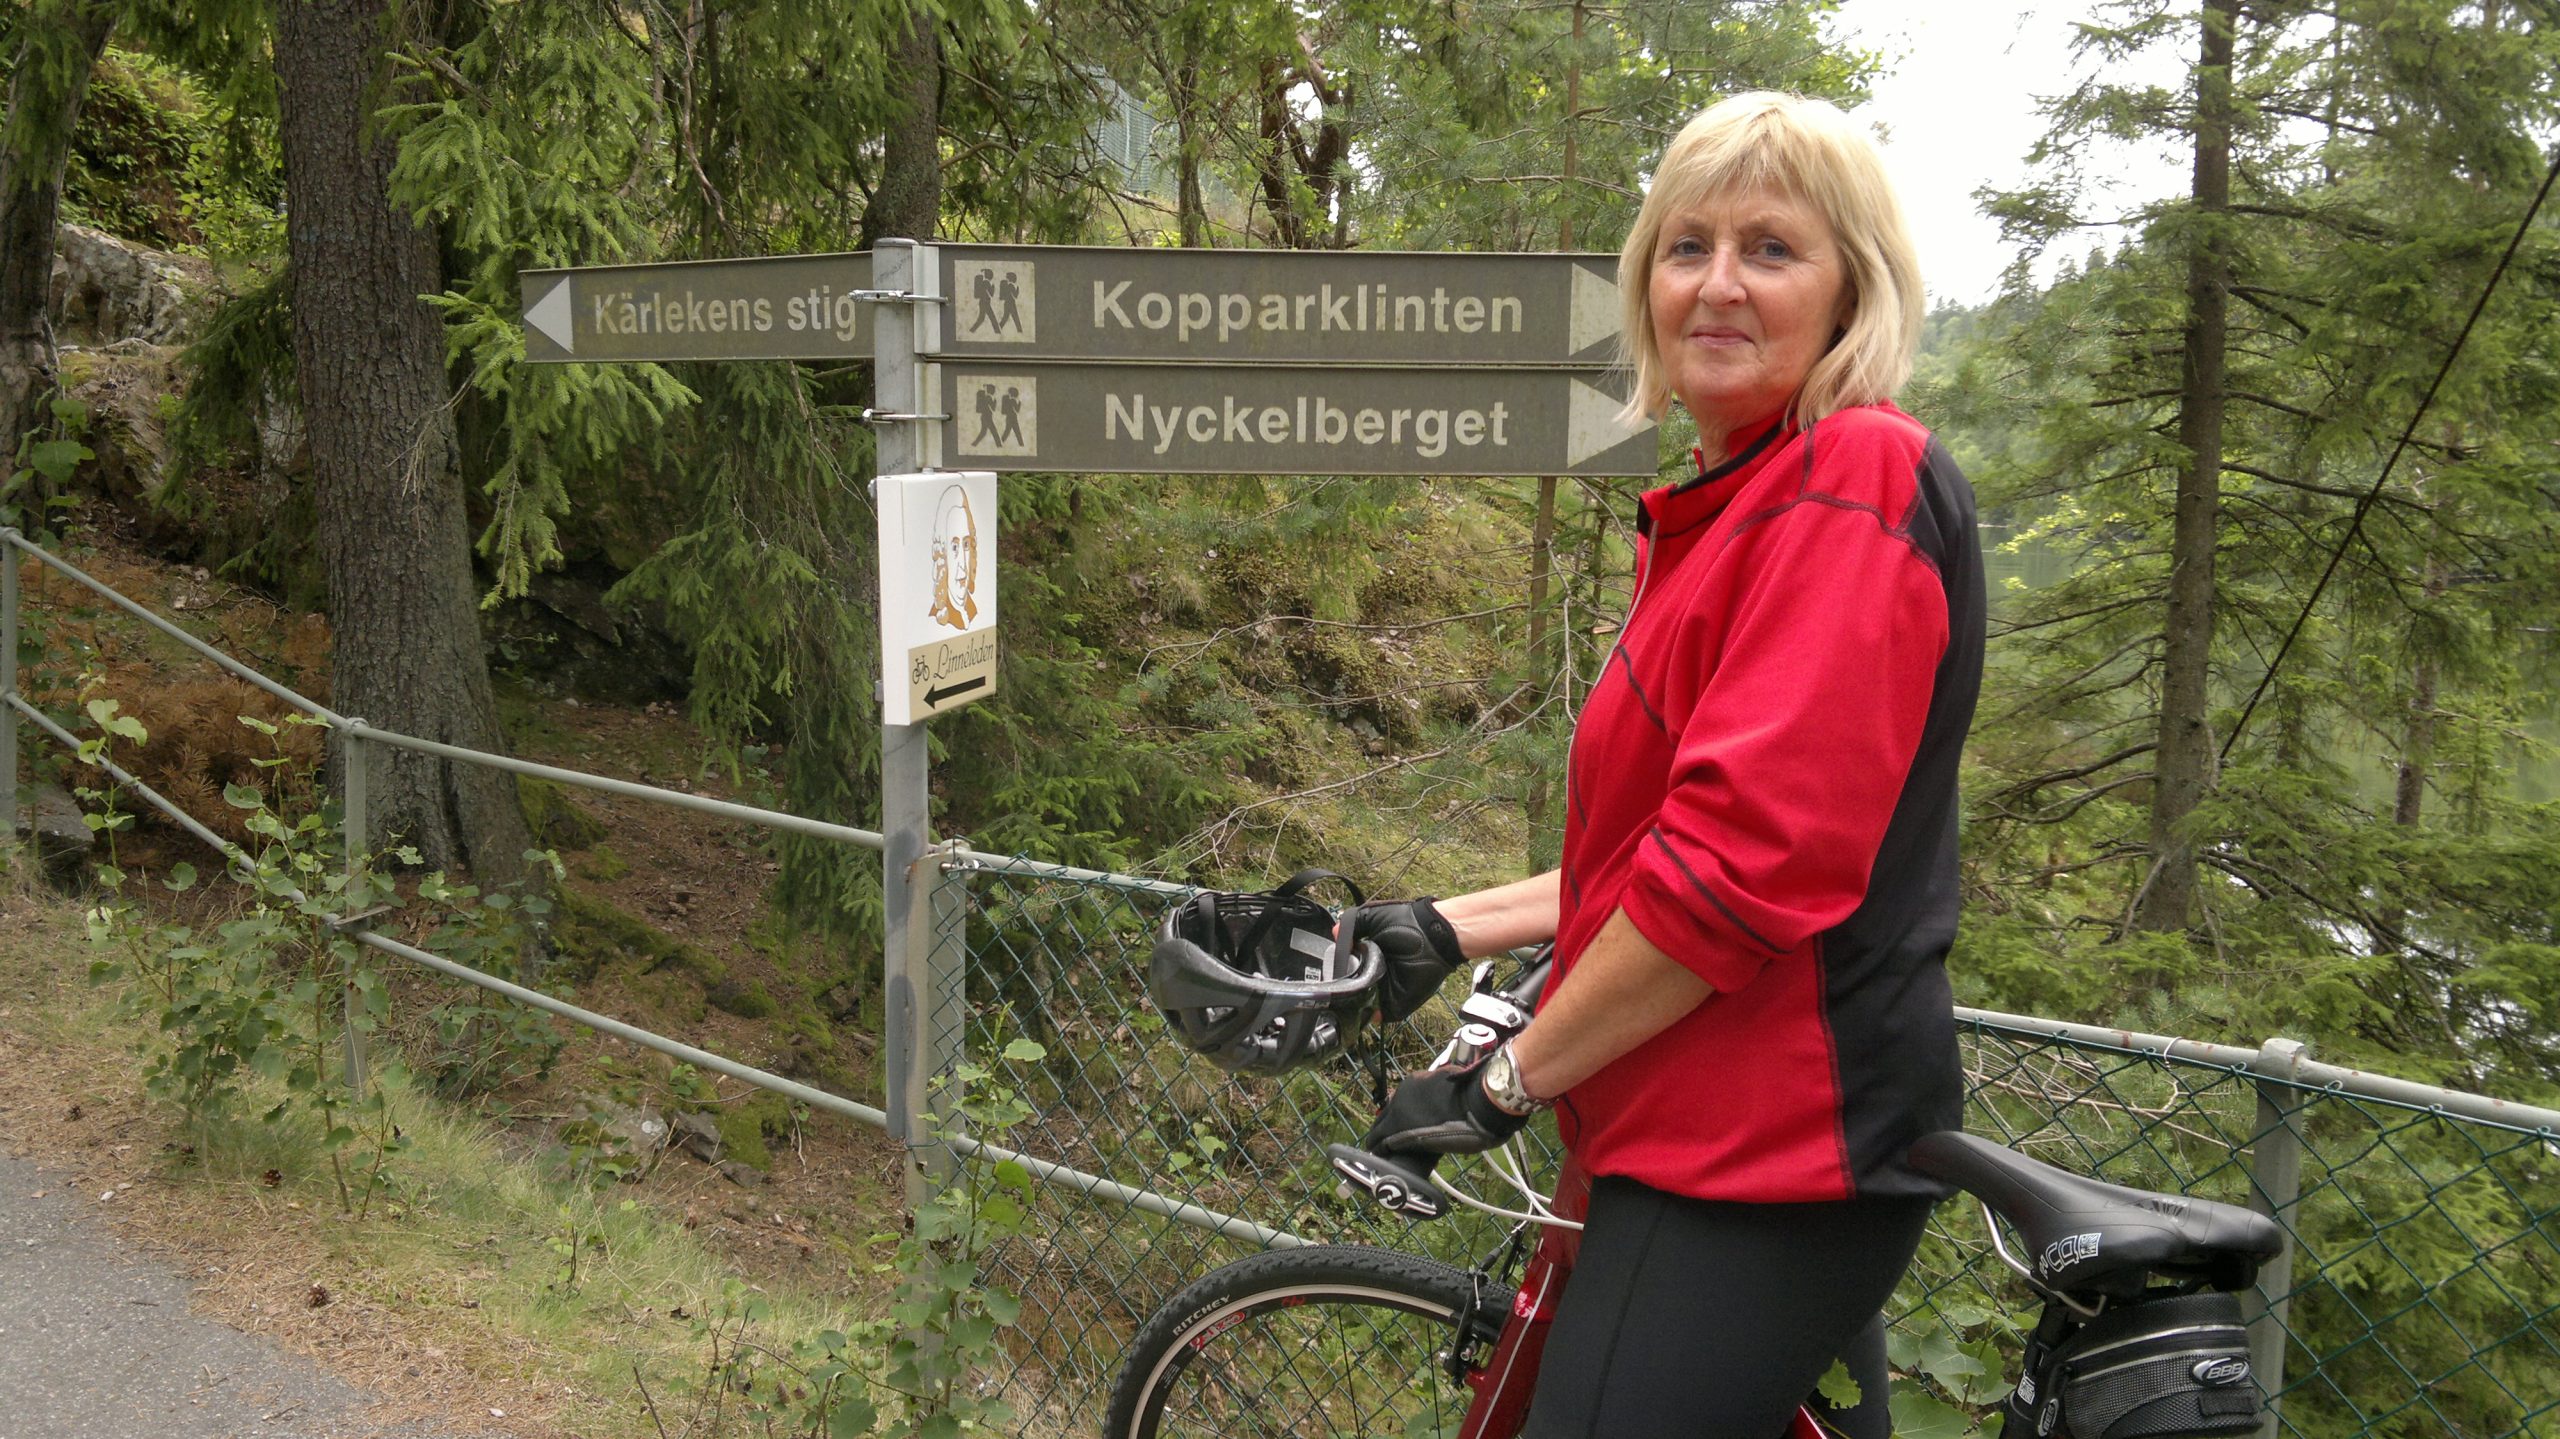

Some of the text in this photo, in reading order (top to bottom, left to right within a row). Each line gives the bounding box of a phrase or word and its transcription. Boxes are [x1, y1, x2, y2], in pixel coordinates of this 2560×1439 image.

[595, 284, 857, 342] Kärlekens stig
[1093, 280, 1523, 342] Kopparklinten
[1105, 394, 1509, 457] Nyckelberget
[1172, 1295, 1230, 1336] RITCHEY
[2206, 1362, 2244, 1379] BBB
